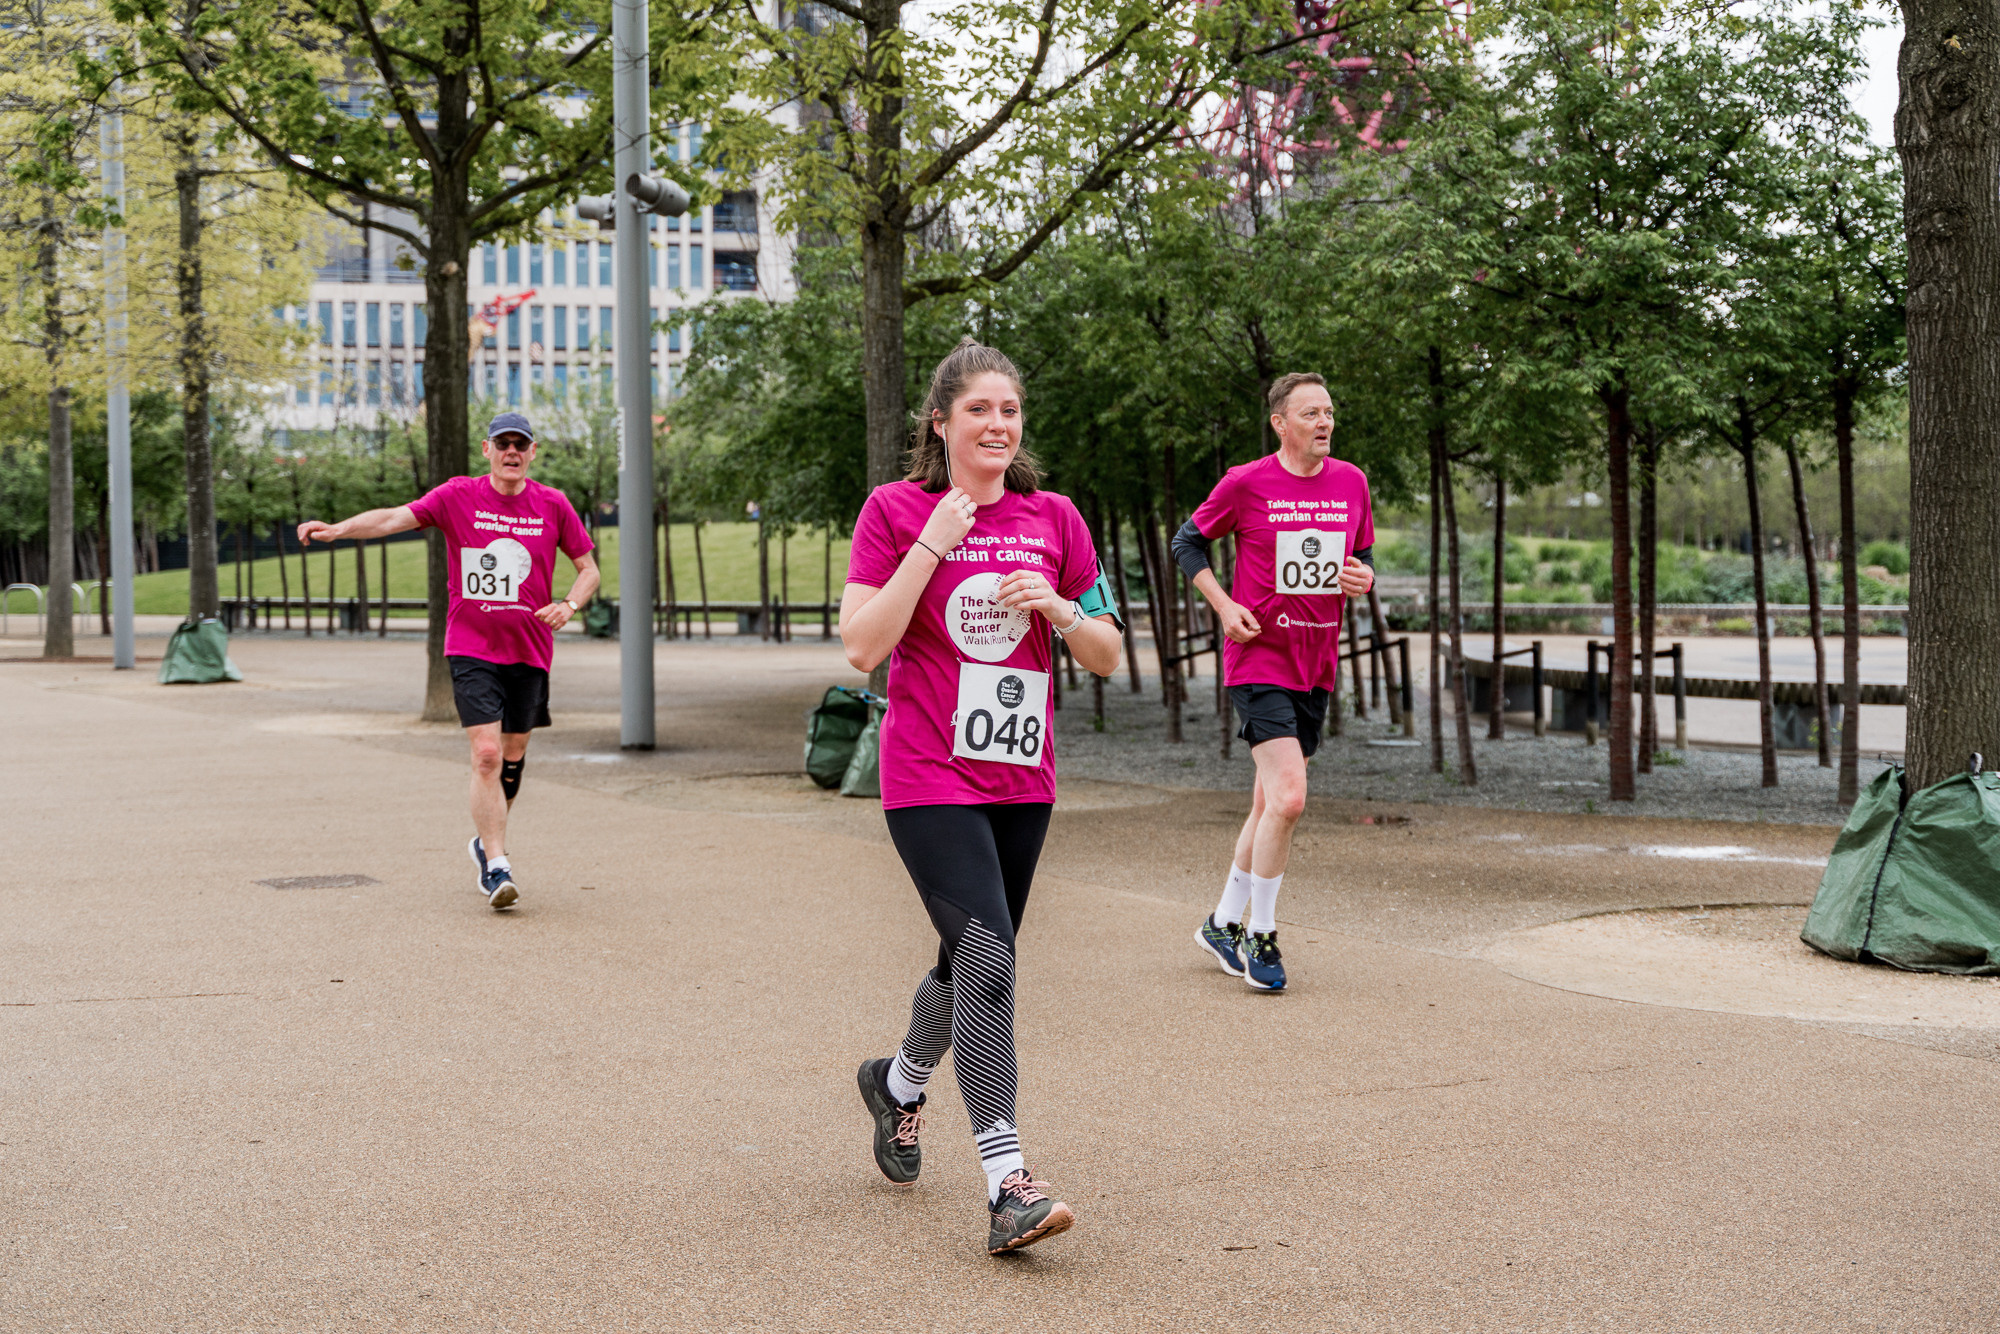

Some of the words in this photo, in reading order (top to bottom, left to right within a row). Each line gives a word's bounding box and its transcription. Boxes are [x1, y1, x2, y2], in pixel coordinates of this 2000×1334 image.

[1266, 500, 1296, 510] Taking
[1297, 501, 1320, 510] steps
[1321, 501, 1330, 509] to
[1331, 500, 1348, 509] beat
[475, 510, 498, 521] Taking
[499, 515, 518, 524] steps
[528, 517, 544, 525] beat
[1268, 510, 1312, 522] ovarian
[1314, 512, 1348, 522] cancer
[473, 521, 510, 533] ovarian
[512, 527, 544, 536] cancer
[967, 536, 1001, 547] steps
[1003, 536, 1017, 545] to
[1019, 534, 1046, 548] beat
[945, 547, 989, 562] arian
[996, 549, 1043, 566] cancer
[1283, 561, 1339, 589] 032
[467, 572, 510, 596] 031
[960, 596, 984, 608] The
[960, 608, 1009, 620] Ovarian
[961, 622, 1001, 634] Cancer
[965, 708, 1040, 757] 048
